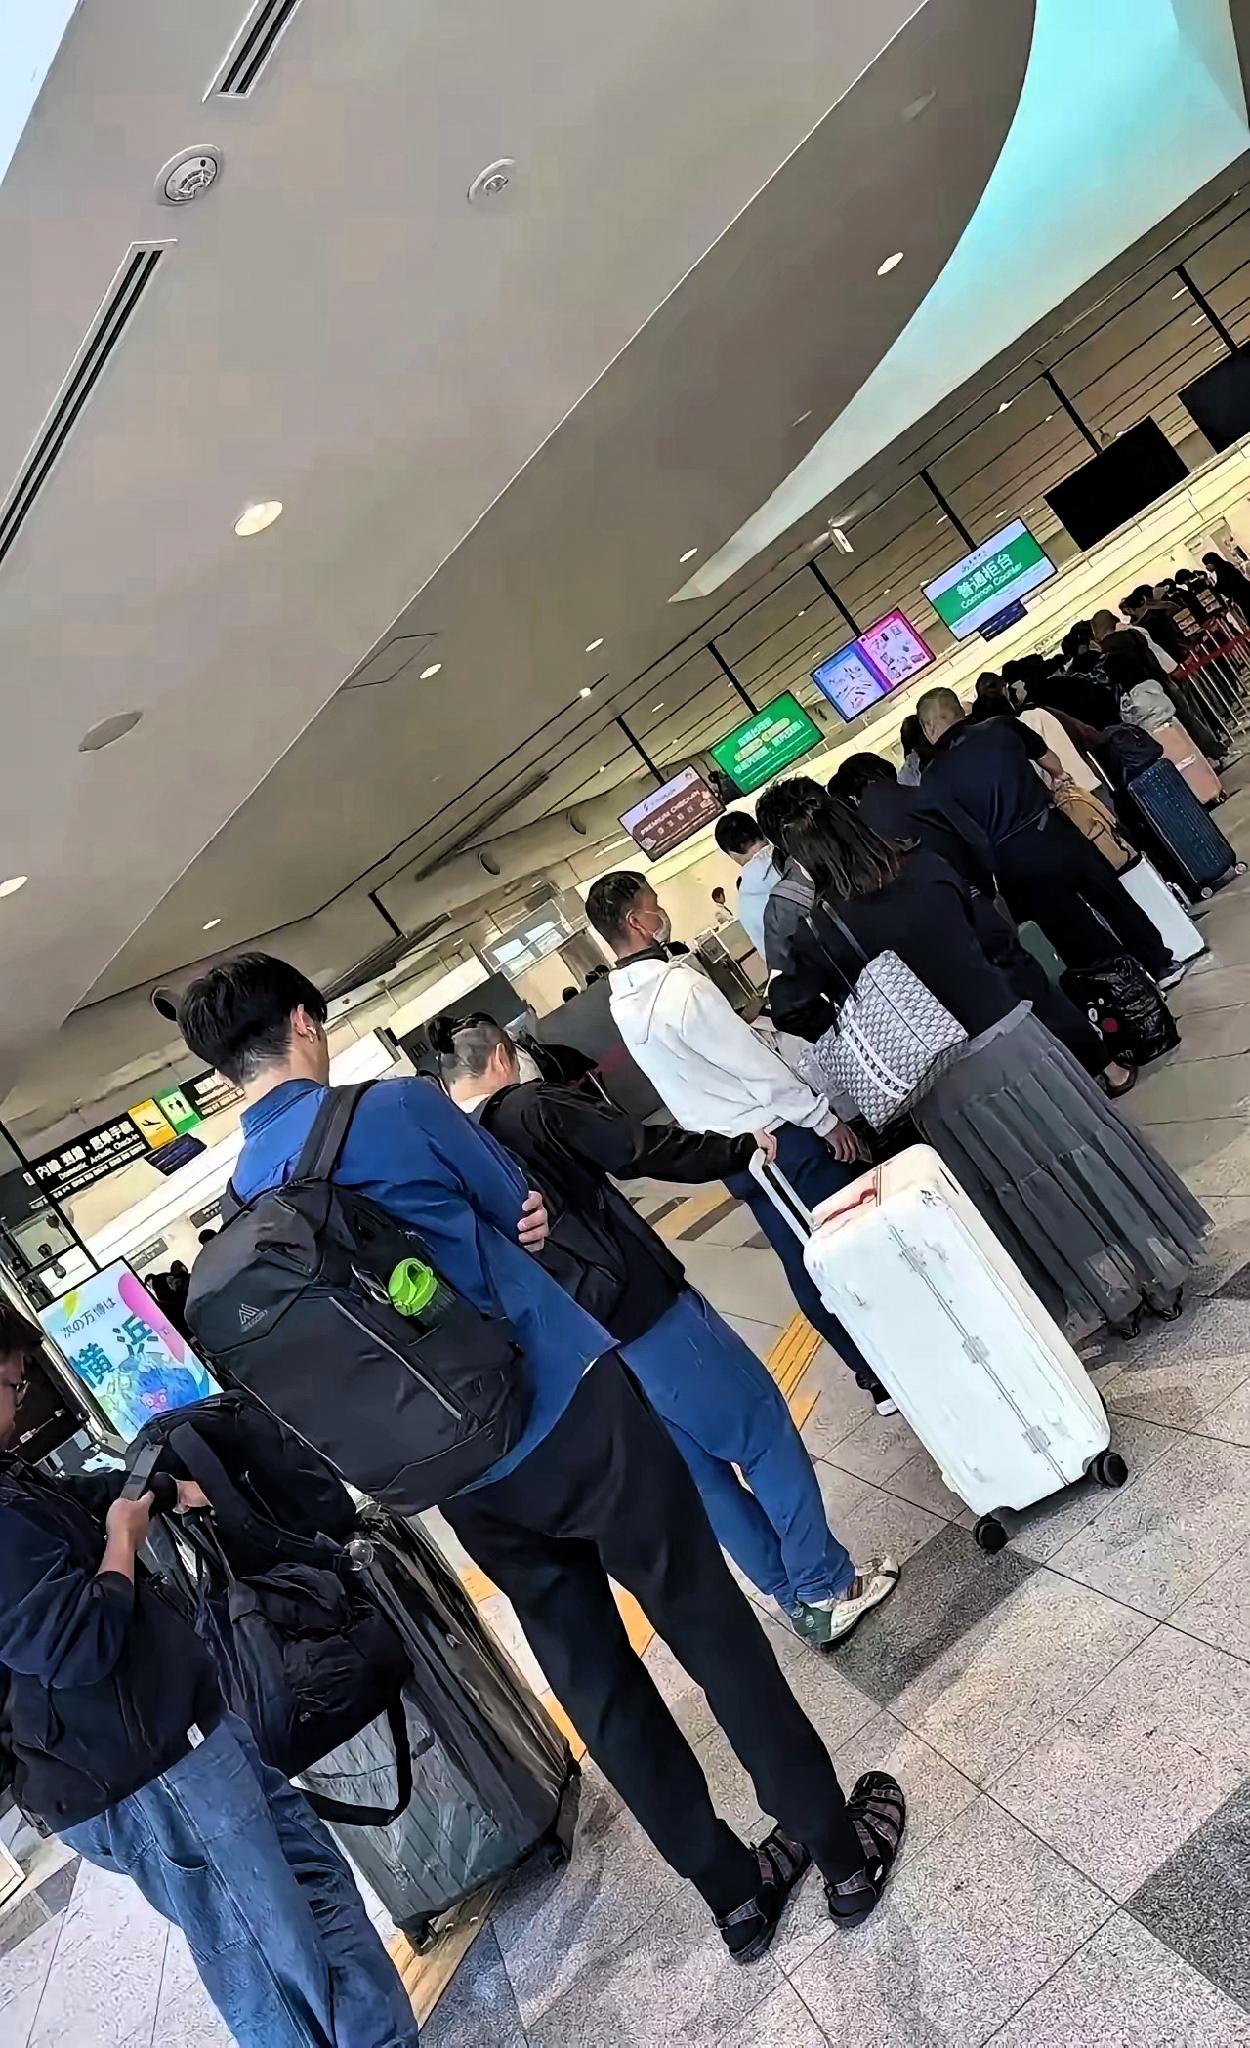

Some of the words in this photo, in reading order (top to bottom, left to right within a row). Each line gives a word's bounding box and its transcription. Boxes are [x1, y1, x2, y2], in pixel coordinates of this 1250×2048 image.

[961, 584, 994, 609] Common
[993, 562, 1022, 585] Counter
[62, 1297, 117, 1339] 次の万博は
[69, 1315, 159, 1389] 横浜
